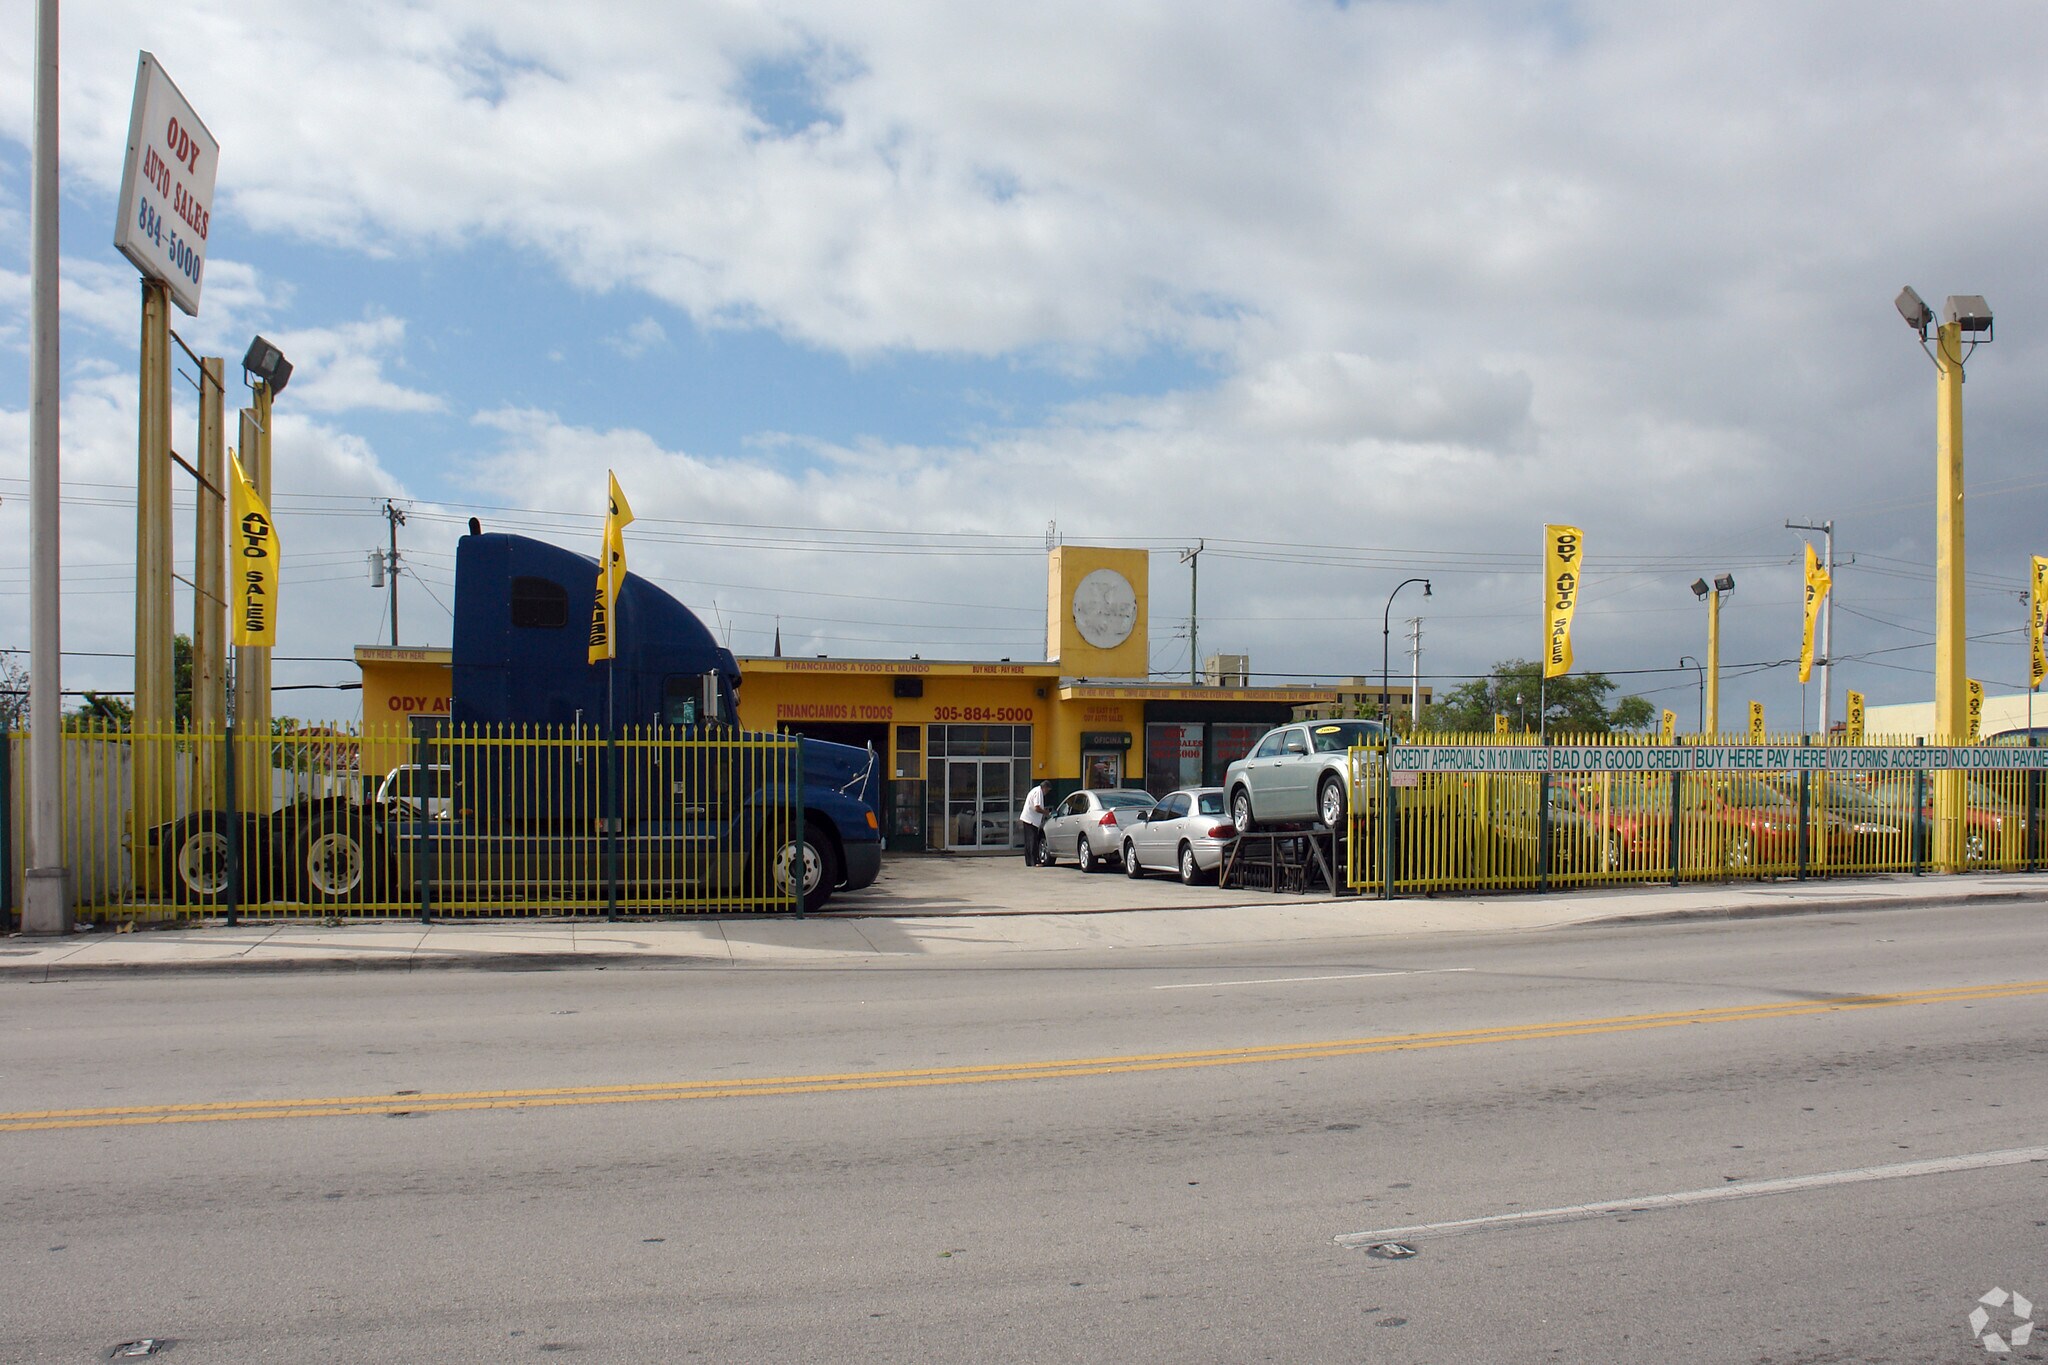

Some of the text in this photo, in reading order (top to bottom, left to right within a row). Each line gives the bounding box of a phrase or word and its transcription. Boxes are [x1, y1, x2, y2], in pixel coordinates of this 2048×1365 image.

[167, 117, 199, 174] ODY
[143, 145, 209, 241] AUTO SALES
[139, 197, 200, 284] 884-5000
[242, 512, 269, 632] AUTO SALES
[1551, 535, 1576, 665] ODY AUTO SALES
[363, 649, 376, 658] BUY
[377, 650, 392, 659] HERE
[397, 650, 408, 659] PAY
[410, 651, 426, 660] HERE
[786, 662, 930, 672] FINANCIAMOS A TODO EL MUNDO
[972, 666, 983, 674] BUY
[984, 666, 997, 674] HERE
[1001, 666, 1011, 674] PAY
[1011, 666, 1025, 674] HERE
[388, 696, 427, 711] ODY
[777, 704, 893, 720] FINANCIAMOS A TODOS
[934, 706, 1033, 721] 305-884-5000
[1094, 736, 1122, 744] OFICINA
[1394, 749, 1548, 770] CREDIT APPROVALS IN 10 MINUTES
[1553, 750, 1692, 769] BAD OR GOOD CREDIT
[1696, 749, 1826, 768] BUY HERE PAY HERE
[1829, 750, 1948, 768] W2 FORMS ACCEPTED
[1952, 750, 2048, 767] NO DOWN PAYME
